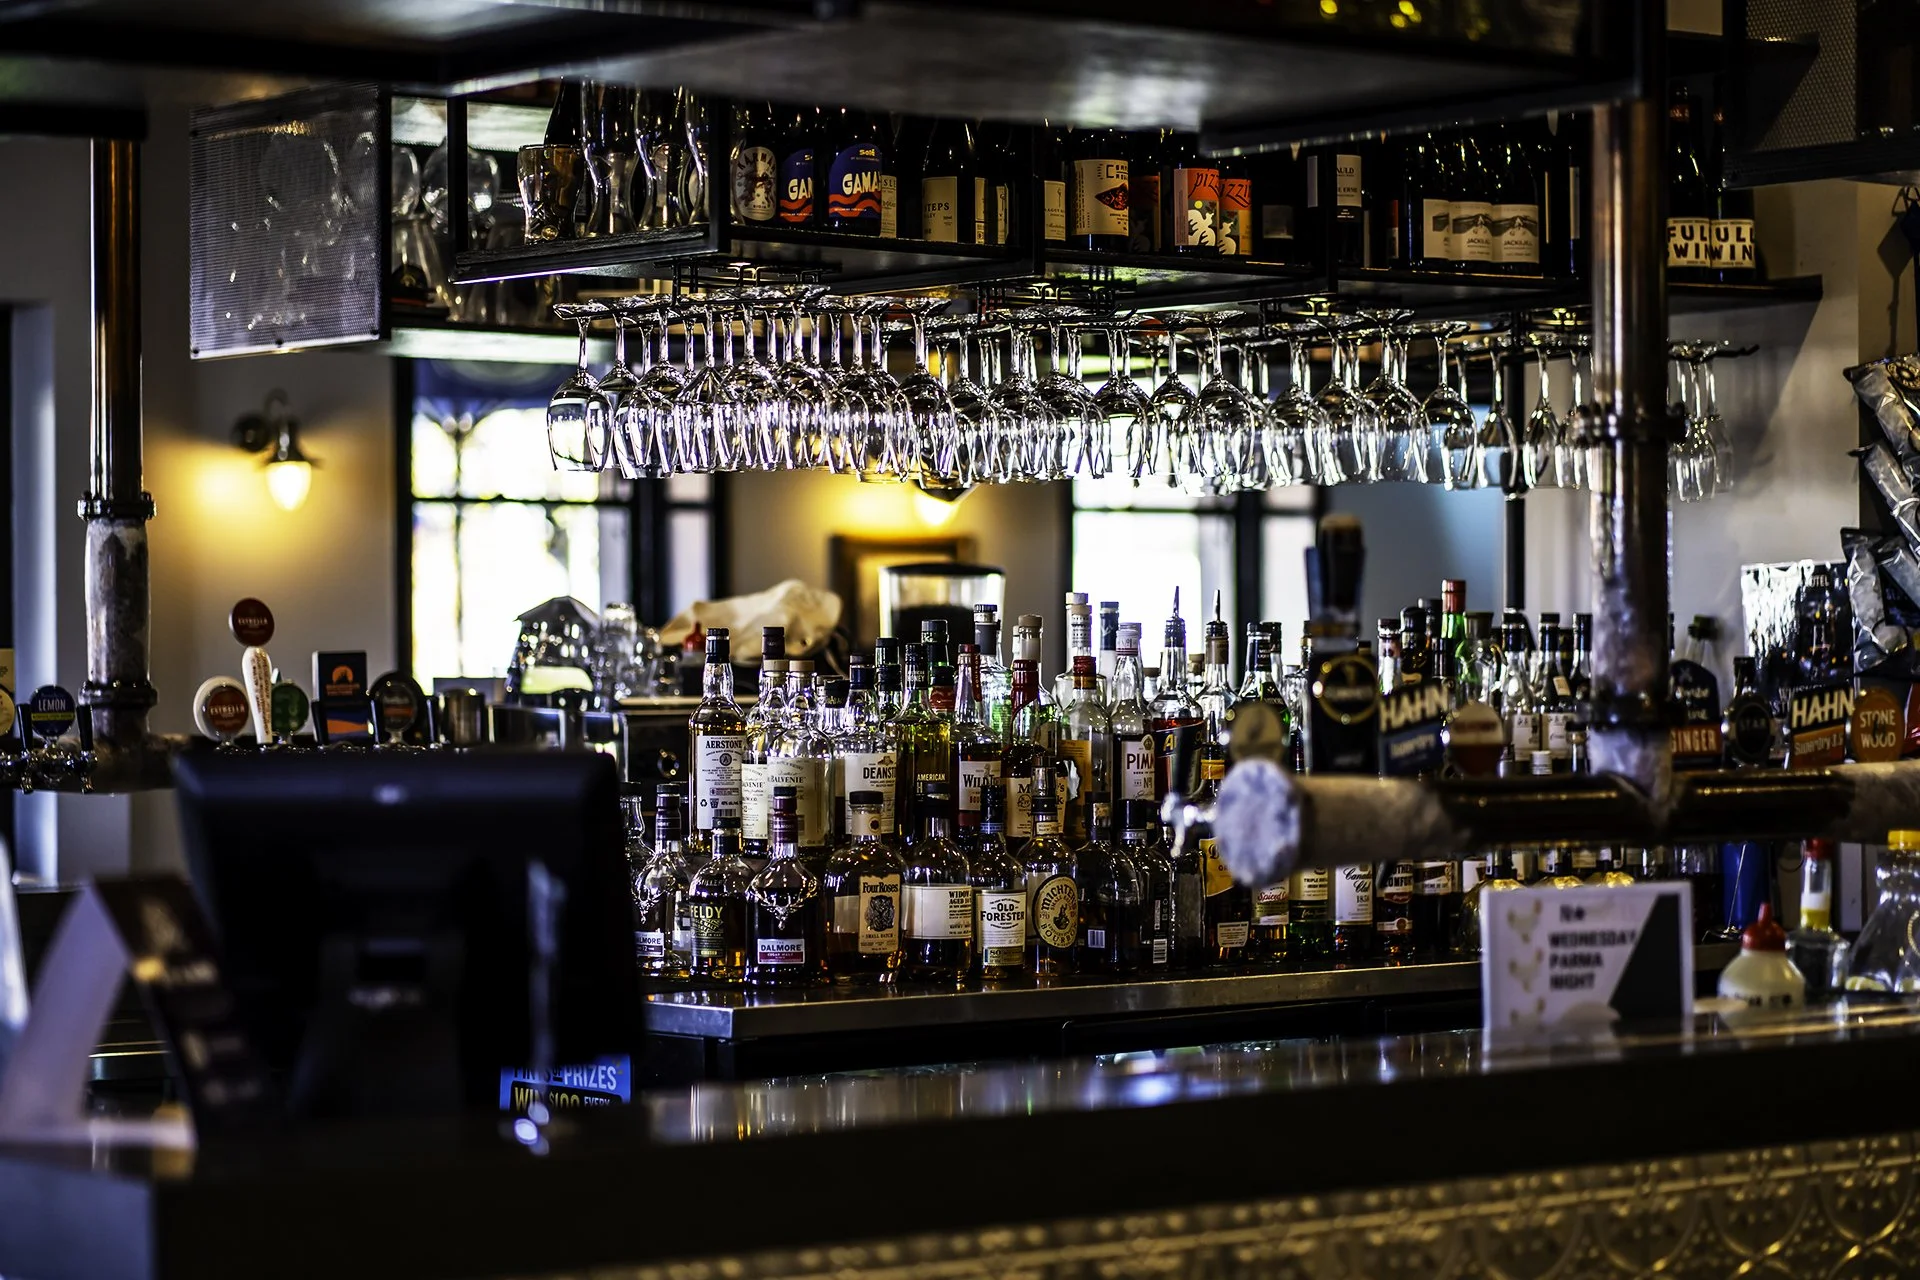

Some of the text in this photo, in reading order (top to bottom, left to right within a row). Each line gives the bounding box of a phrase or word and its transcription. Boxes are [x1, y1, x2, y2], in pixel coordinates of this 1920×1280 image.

[38, 698, 66, 712] LEMON
[1792, 687, 1856, 729] HAHN
[1860, 709, 1896, 728] STONE
[706, 740, 742, 749] AERSTONE
[1860, 731, 1896, 748] WOOD
[916, 773, 946, 781] AMERICAN
[997, 903, 1014, 911] OLD
[981, 911, 1024, 921] FORESTER
[564, 1063, 617, 1091] PRIZES
